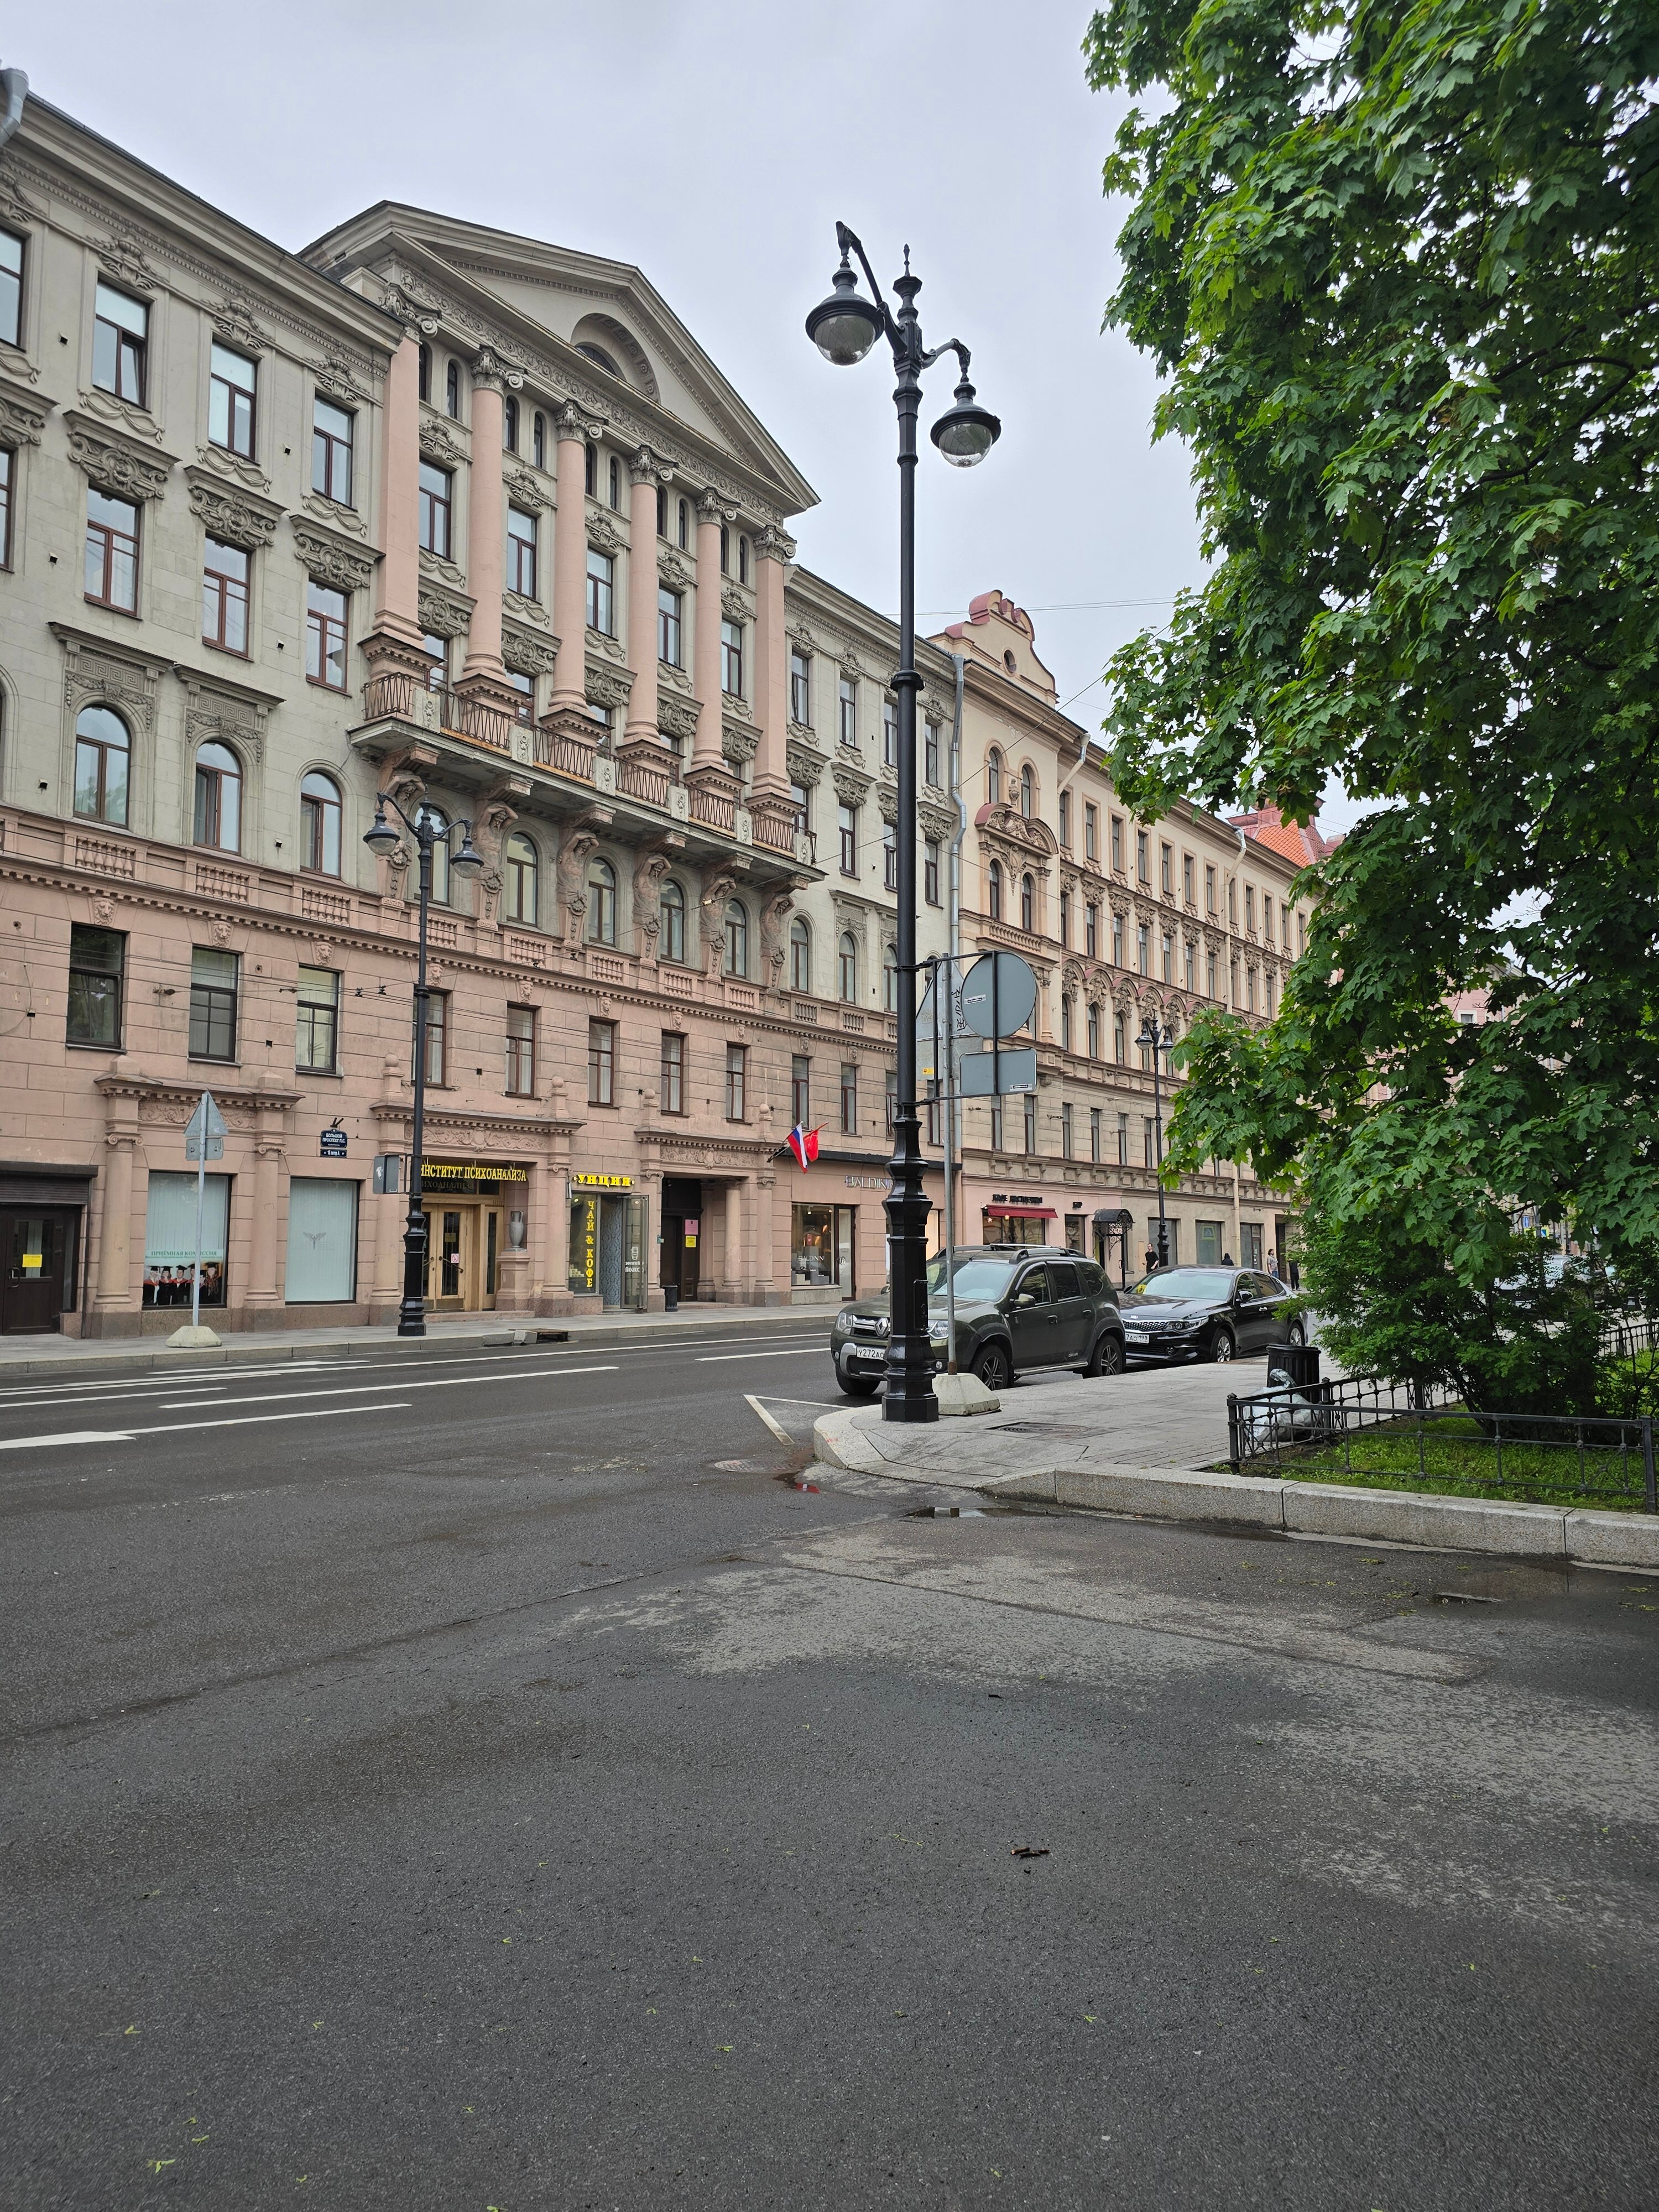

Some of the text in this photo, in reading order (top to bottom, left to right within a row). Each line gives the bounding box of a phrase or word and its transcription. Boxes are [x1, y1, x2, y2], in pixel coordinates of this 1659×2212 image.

[464, 1167, 526, 1181] ПСИХОАНАЛИЗА
[577, 1175, 631, 1187] УНЦИЯ
[585, 1201, 594, 1288] ЧАЙ & КОФЕ
